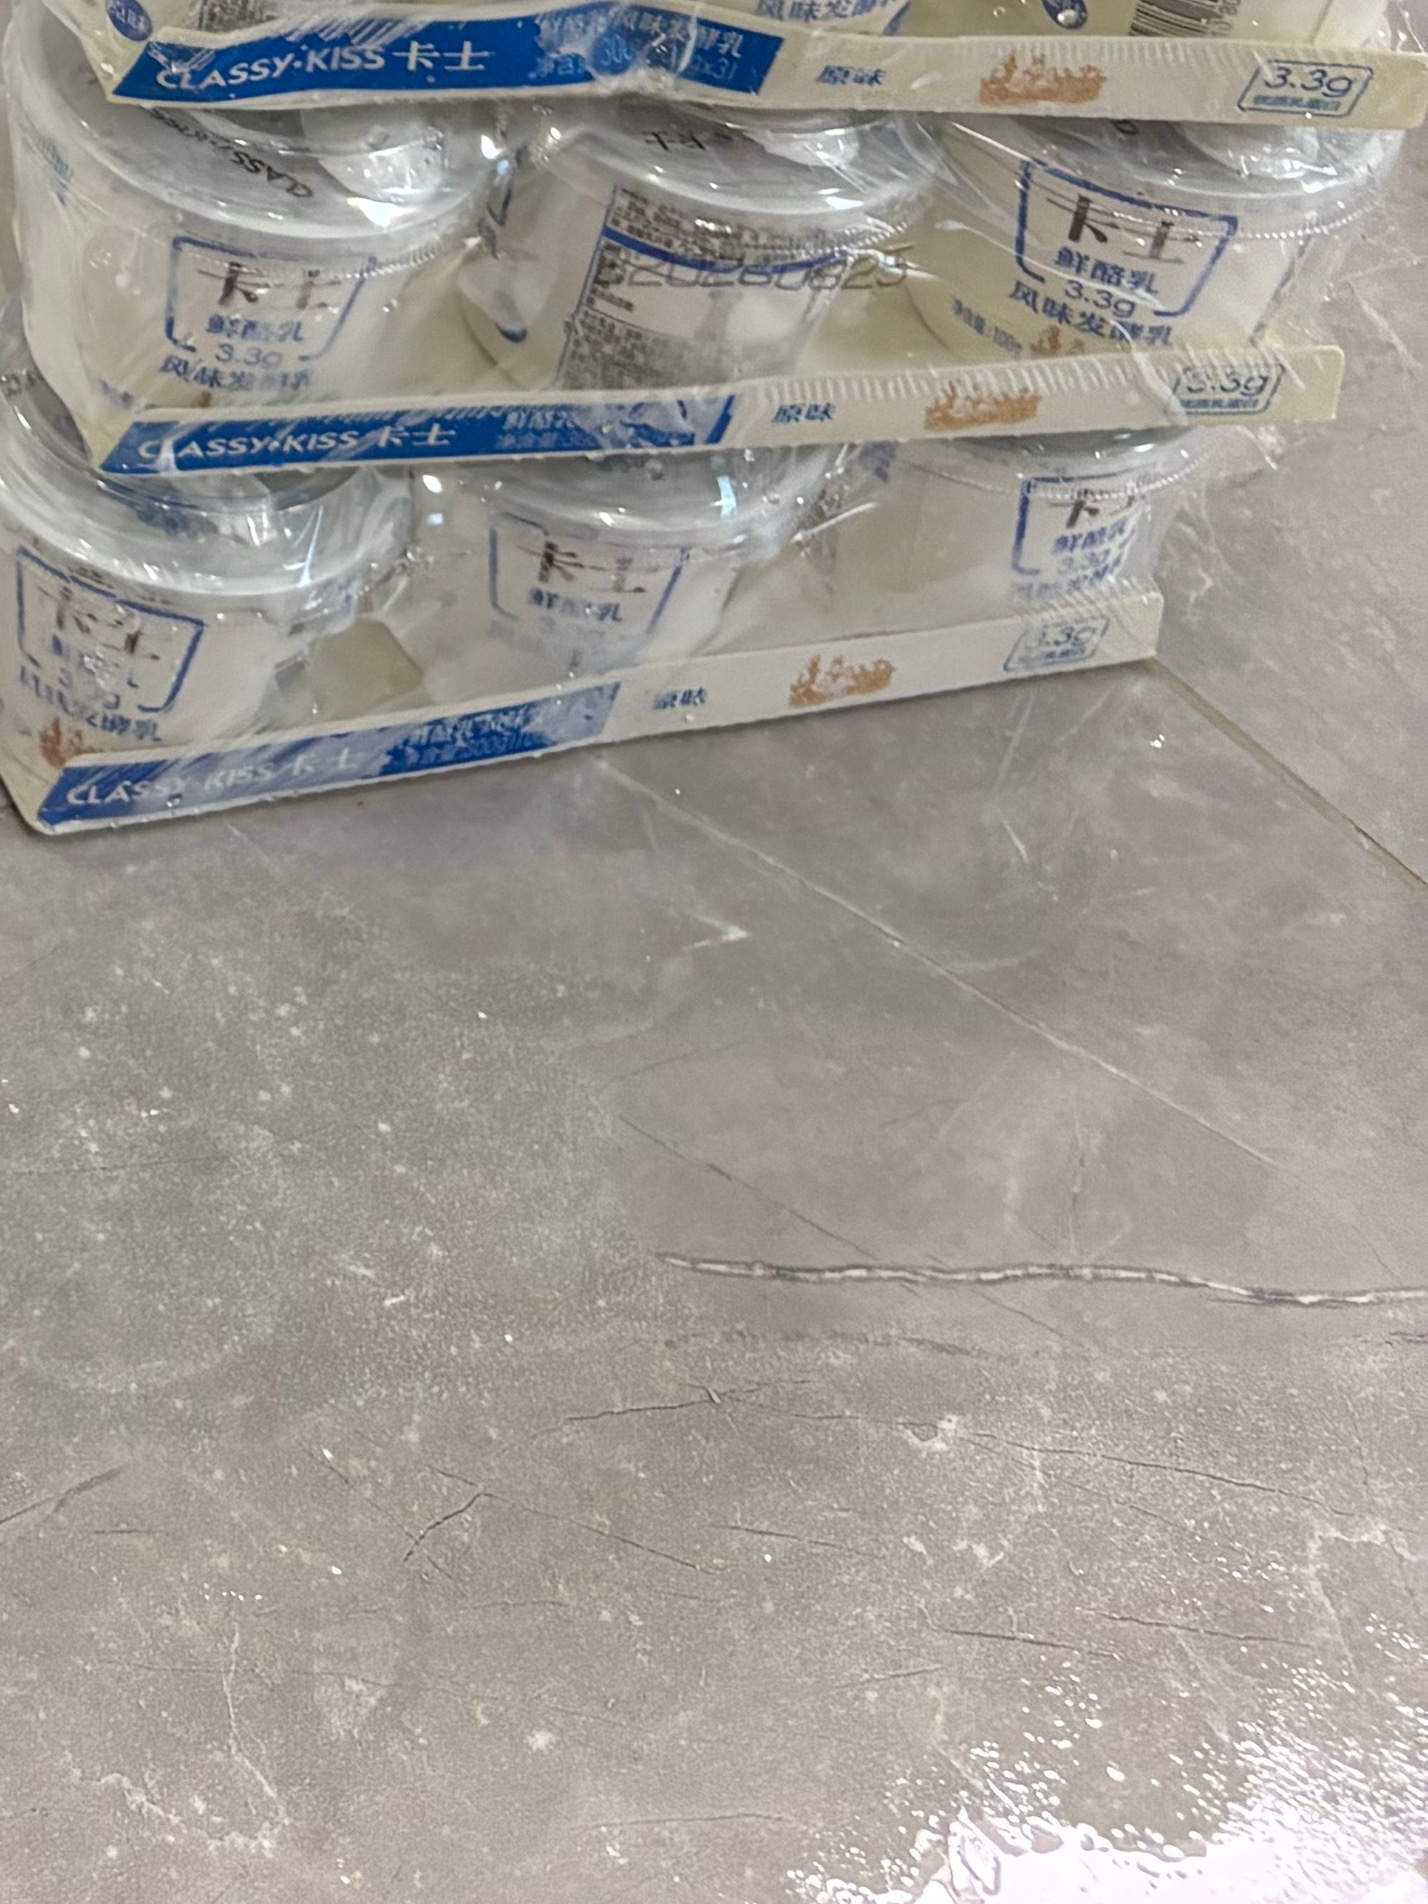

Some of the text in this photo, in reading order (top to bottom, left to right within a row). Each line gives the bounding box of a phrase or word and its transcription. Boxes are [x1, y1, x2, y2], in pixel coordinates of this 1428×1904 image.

[391, 40, 493, 71] 卡士
[817, 63, 886, 86] 原味
[1263, 65, 1353, 98] 3.3g
[1047, 192, 1200, 265] 卡士
[1054, 245, 1159, 294] 鲜酪乳
[1009, 279, 1173, 346] 风味发酵乳
[1065, 278, 1137, 319] 3.3g
[771, 399, 835, 424] 原味
[375, 422, 457, 447] 卡士
[652, 686, 708, 710] 原味
